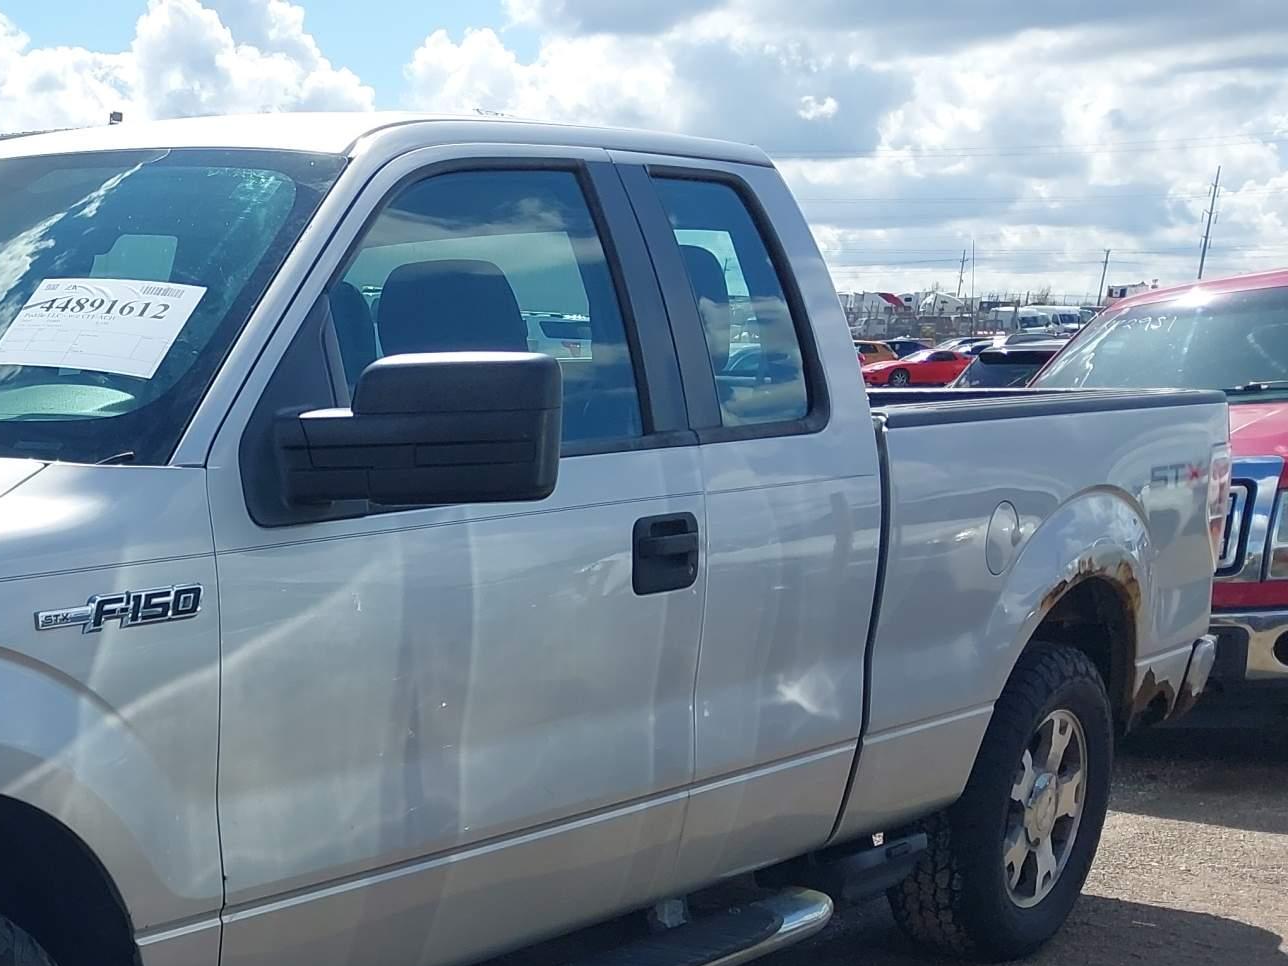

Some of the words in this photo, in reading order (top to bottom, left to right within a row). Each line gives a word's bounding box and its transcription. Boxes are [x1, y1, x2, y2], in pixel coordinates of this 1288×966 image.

[39, 297, 170, 320] 44891612
[40, 613, 71, 627] STX
[84, 584, 203, 632] F-150
